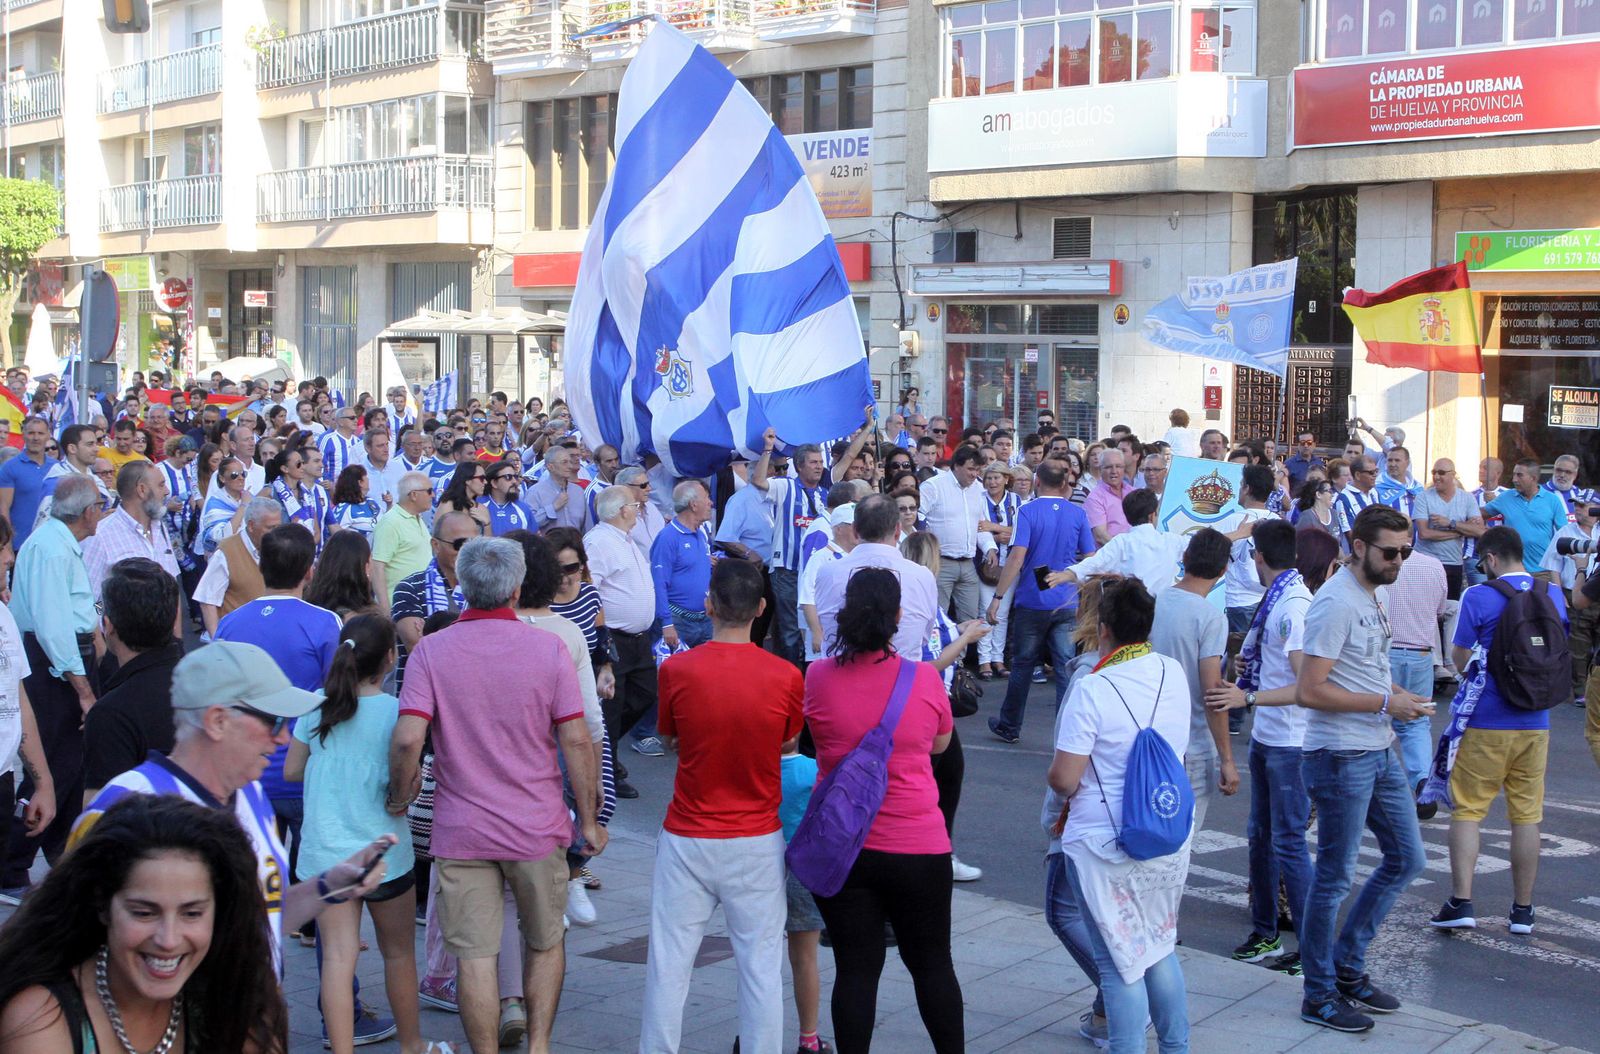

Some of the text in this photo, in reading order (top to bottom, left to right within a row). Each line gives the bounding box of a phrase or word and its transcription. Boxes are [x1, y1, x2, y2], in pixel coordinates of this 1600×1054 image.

[1370, 65, 1445, 85] CÁMARA DE
[1370, 76, 1524, 102] LA PROPIEDAD URBANA
[1370, 94, 1524, 119] DE HUELVA Y PROVINCIA
[1370, 112, 1523, 132] www.propiedadurbanahuelva.com
[803, 136, 869, 160] VENDE
[830, 165, 850, 178] 423
[1584, 234, 1592, 247] Y
[1544, 252, 1560, 265] 691
[1565, 252, 1582, 265] 579
[1310, 301, 1316, 312] 4
[1529, 302, 1549, 311] EVENTOS
[1557, 319, 1579, 328] JARDINES
[1509, 335, 1532, 345] ALQUILER
[1533, 335, 1539, 343] DE
[1552, 390, 1598, 404] SE ALQUILA
